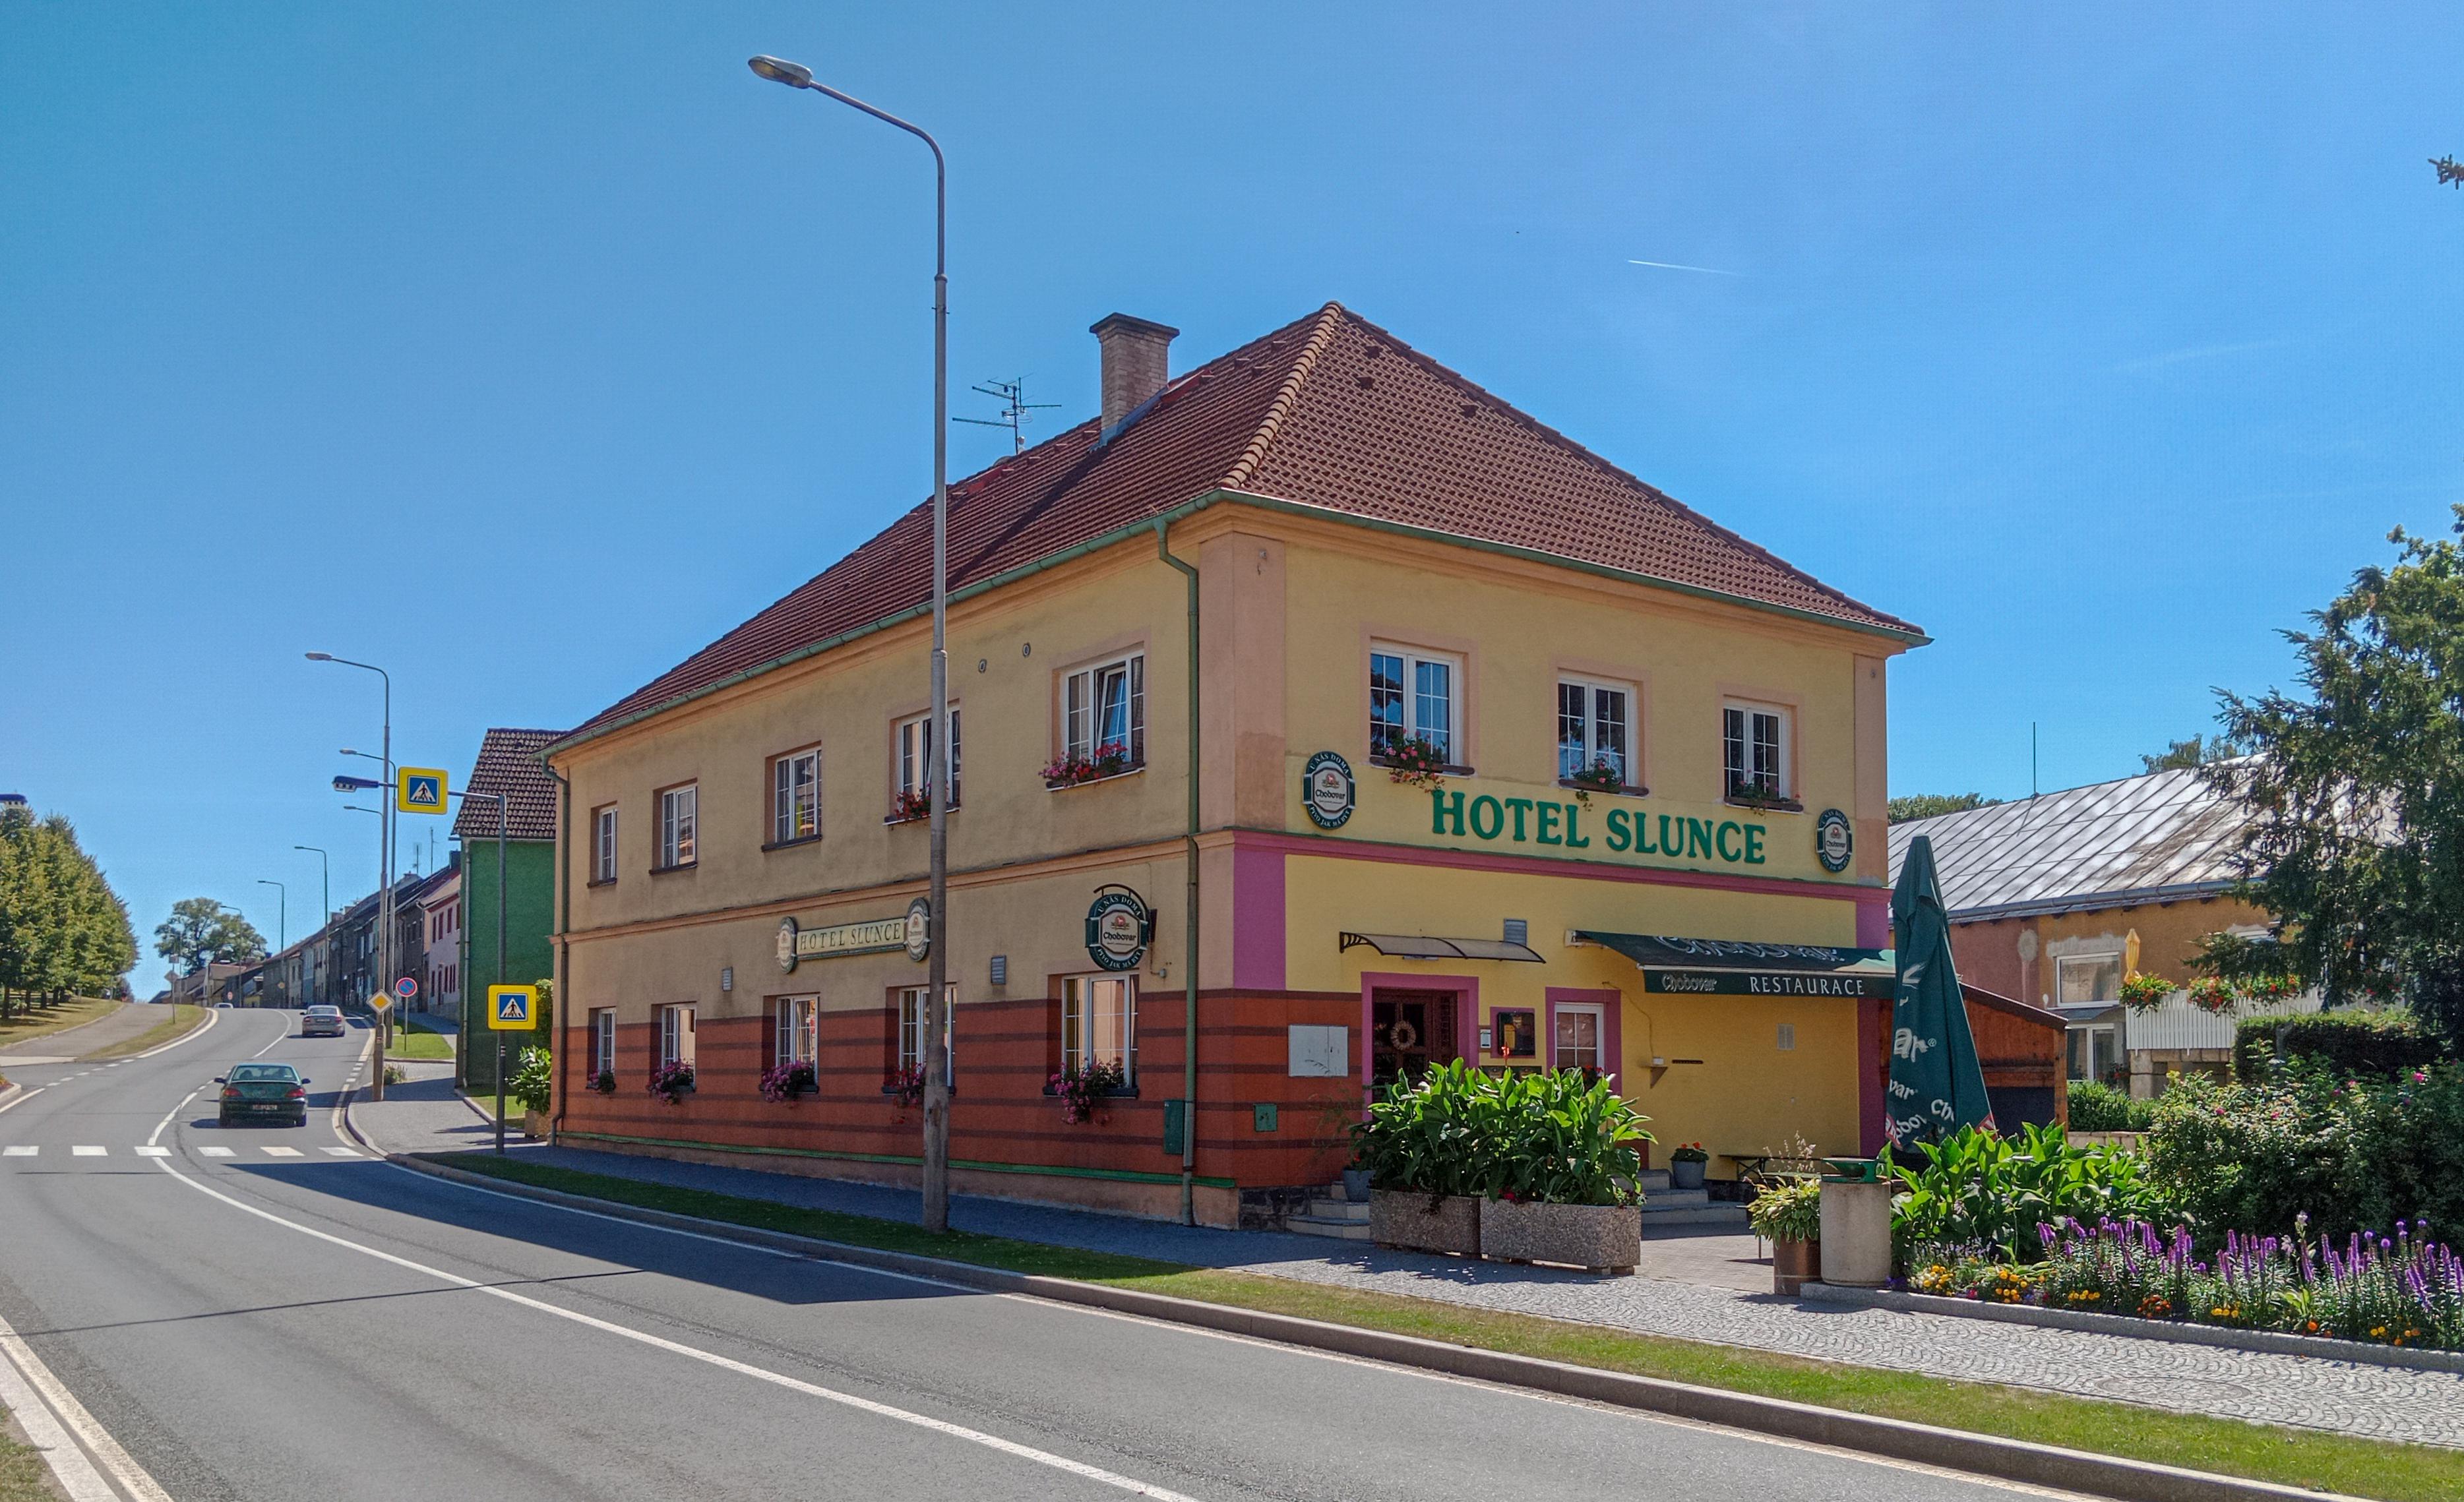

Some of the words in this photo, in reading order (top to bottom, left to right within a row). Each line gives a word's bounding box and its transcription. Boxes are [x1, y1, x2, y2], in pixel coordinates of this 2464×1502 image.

[1331, 754, 1349, 774] DOMA
[1315, 789, 1345, 800] Chodovar
[1432, 790, 1590, 848] HOTEL
[1606, 809, 1766, 864] SLUNCE
[1121, 897, 1141, 916] DOMA
[799, 930, 846, 950] HOTEL
[850, 923, 901, 945] SLUNCE
[1103, 932, 1136, 942] Chodovar
[1750, 976, 1865, 995] RESTAURACE
